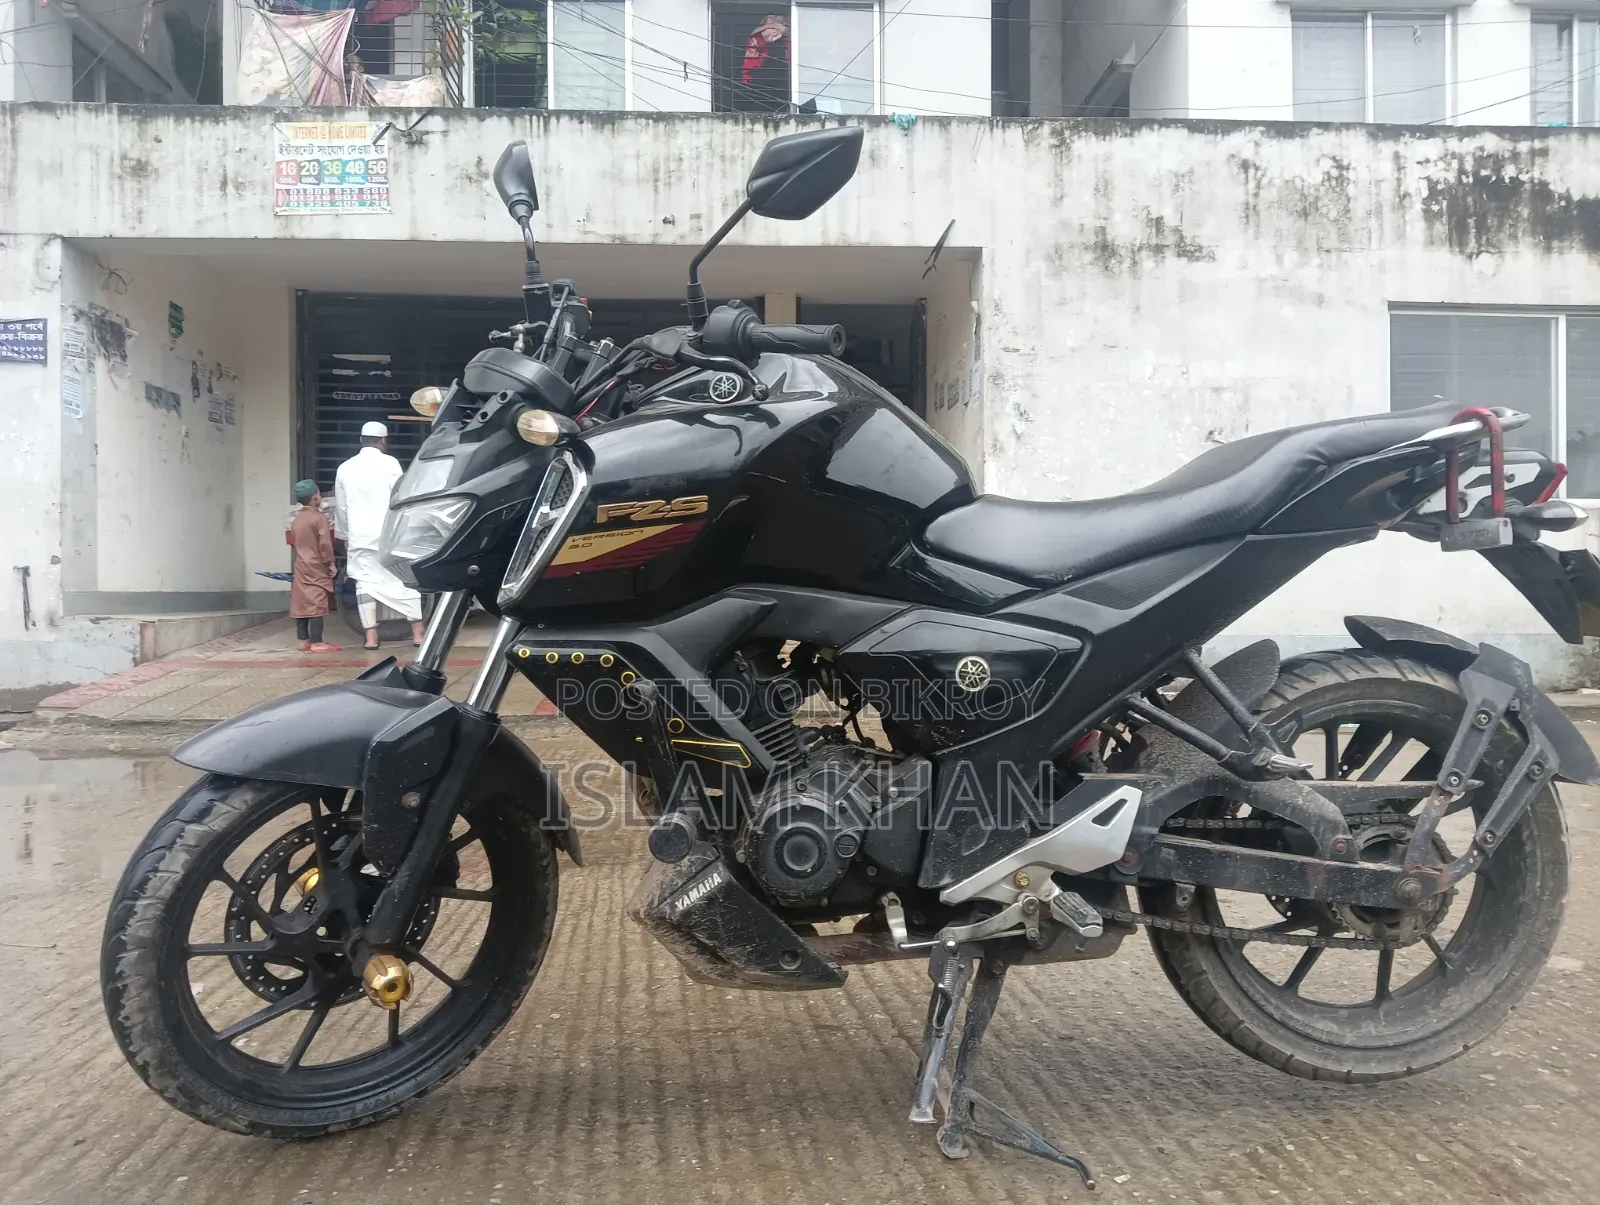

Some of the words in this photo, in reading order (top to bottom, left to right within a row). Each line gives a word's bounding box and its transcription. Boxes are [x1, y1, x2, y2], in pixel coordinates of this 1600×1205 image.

[345, 126, 368, 139] LIMITED
[278, 143, 315, 156] ইন্টারনেট
[317, 145, 345, 156] সংযোগ
[571, 529, 644, 543] VERSION
[568, 542, 593, 551] 3.0
[675, 872, 723, 911] YAMAHA
